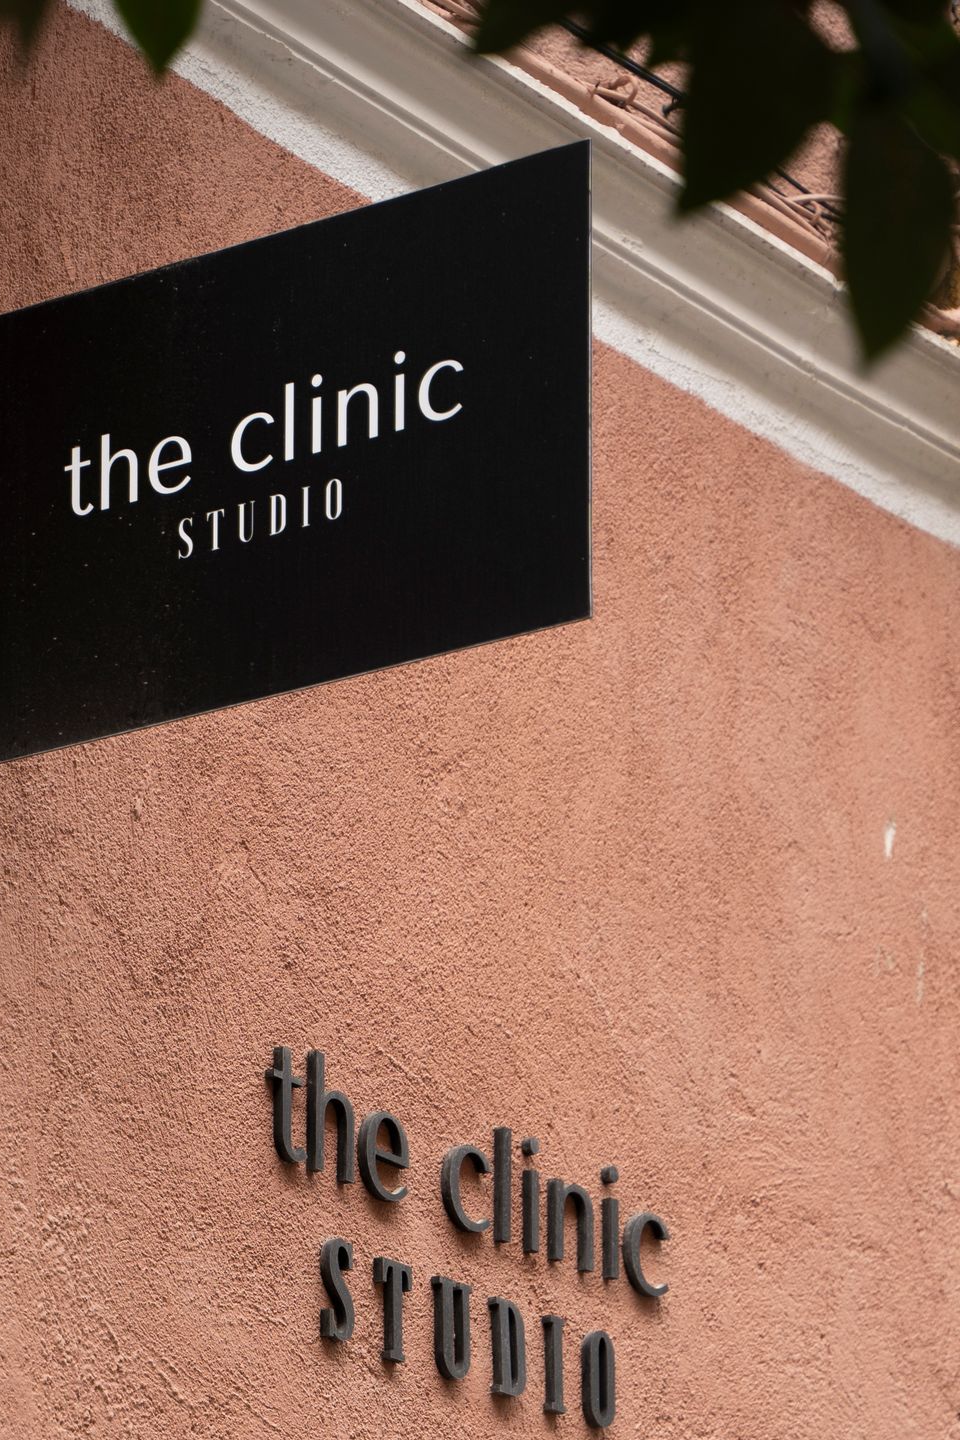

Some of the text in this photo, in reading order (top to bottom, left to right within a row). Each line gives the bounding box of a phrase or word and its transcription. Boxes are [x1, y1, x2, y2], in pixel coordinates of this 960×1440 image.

[64, 350, 464, 516] the clinic
[178, 478, 343, 559] STUDIO
[265, 1046, 669, 1297] the clinic
[320, 1237, 616, 1428] STUDIO
